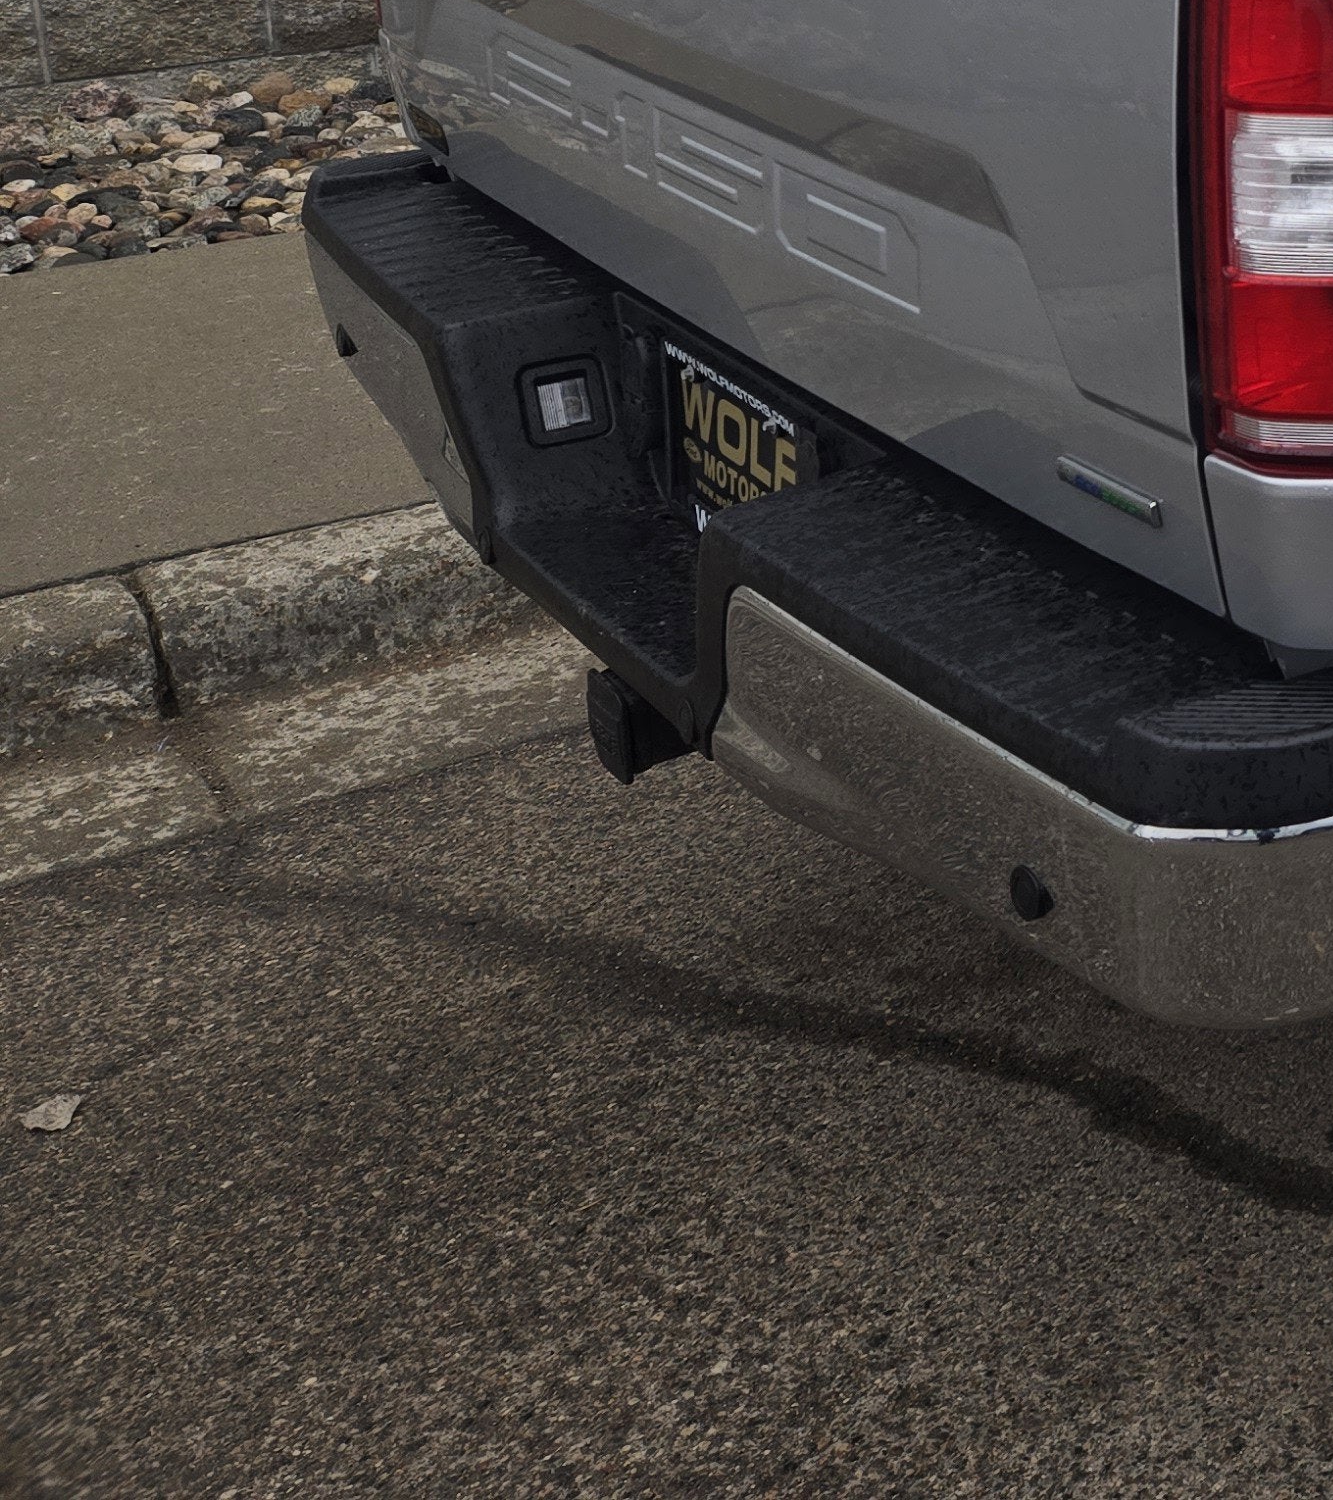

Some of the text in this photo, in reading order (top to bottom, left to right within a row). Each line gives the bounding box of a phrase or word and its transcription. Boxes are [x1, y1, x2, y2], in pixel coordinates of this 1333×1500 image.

[486, 29, 921, 314] F-150
[681, 378, 796, 492] WOLF
[703, 449, 768, 503] MOTOR
